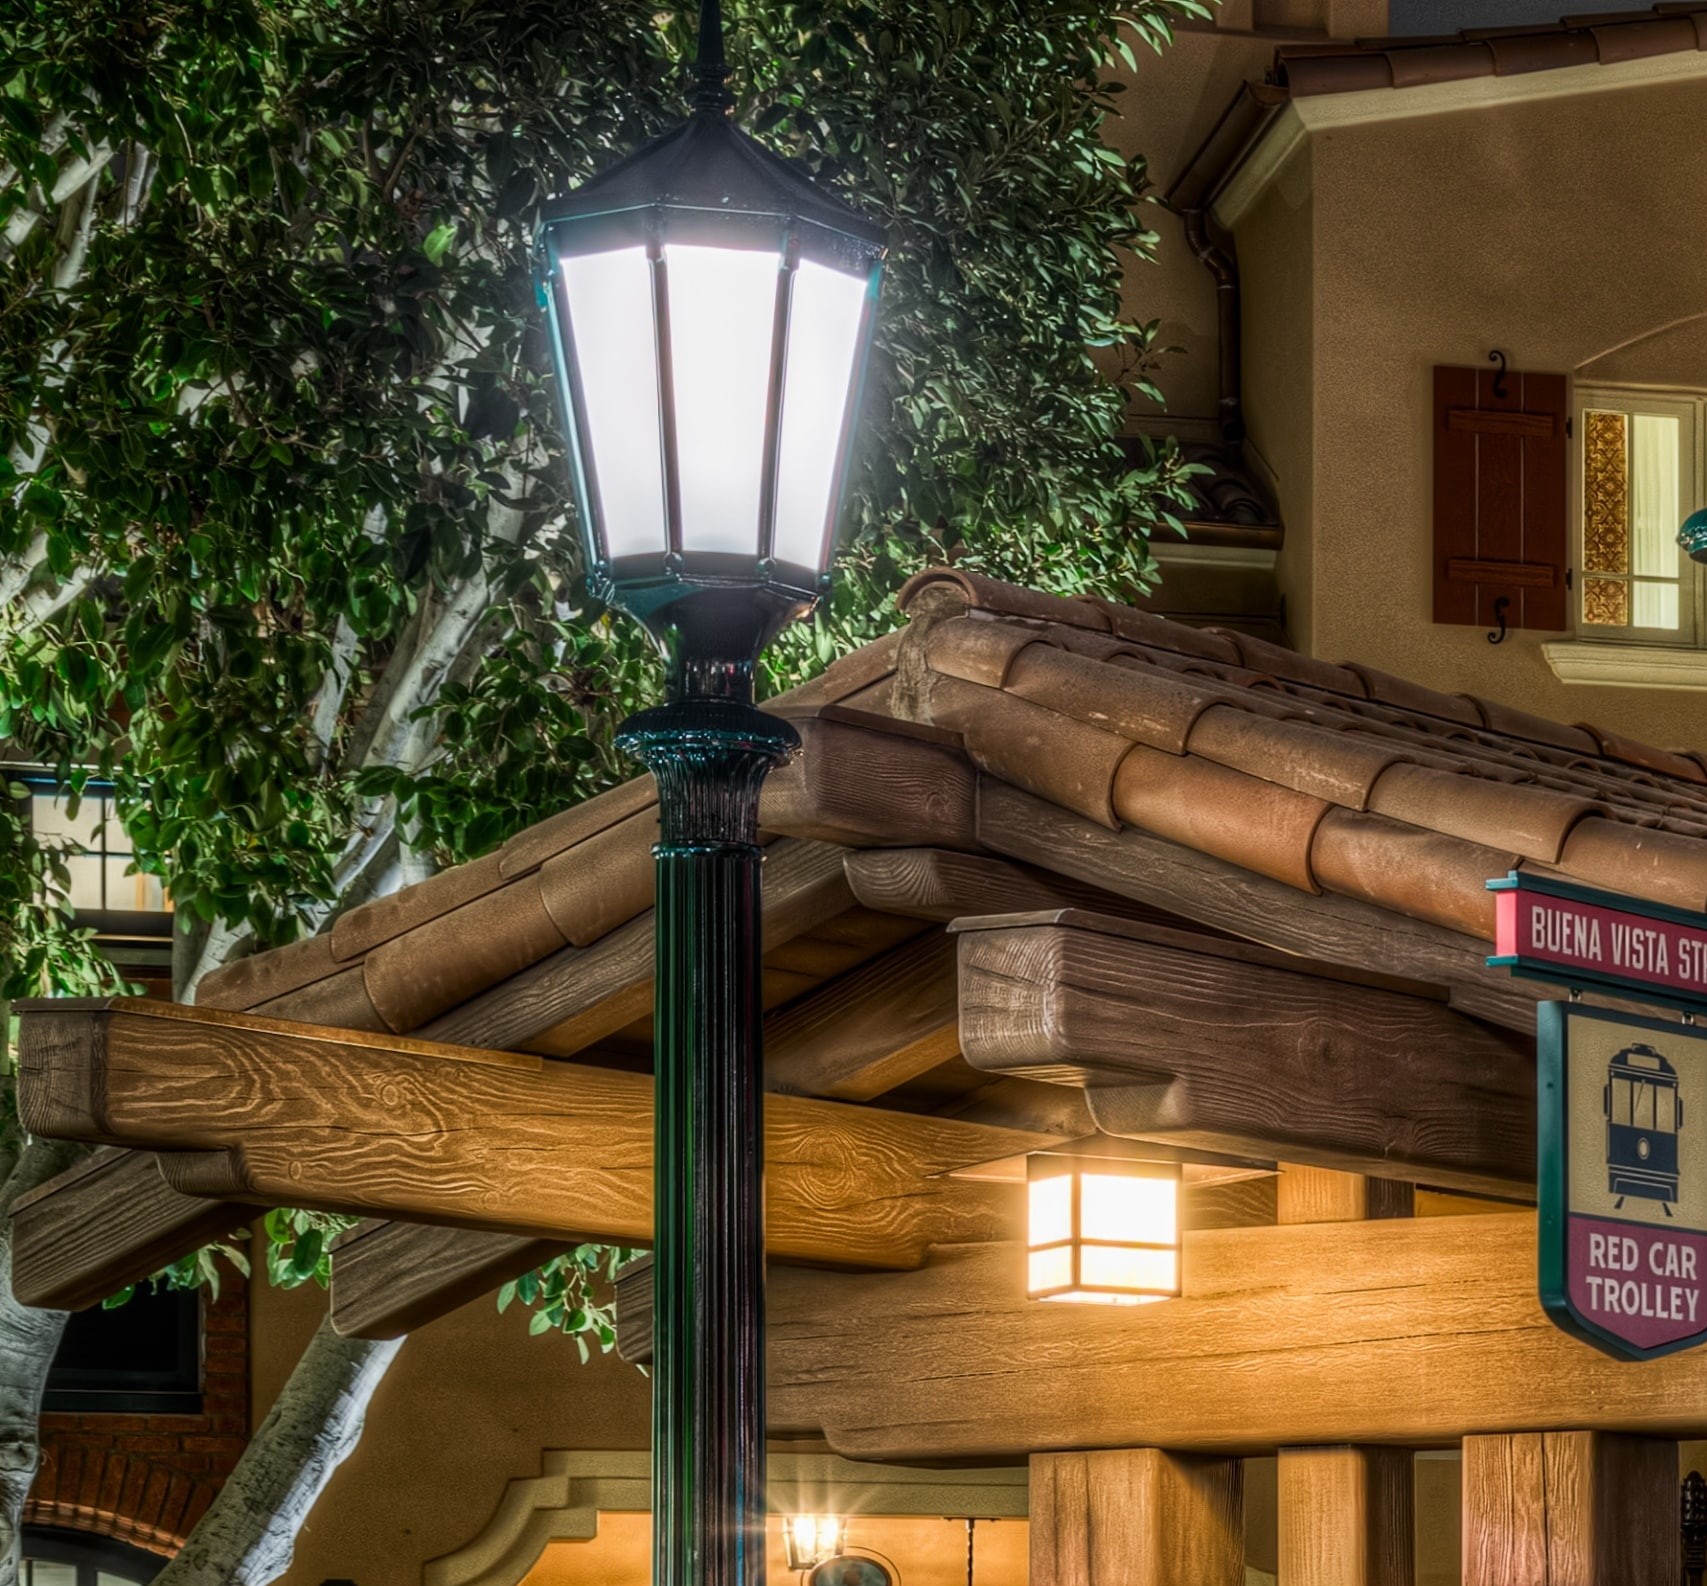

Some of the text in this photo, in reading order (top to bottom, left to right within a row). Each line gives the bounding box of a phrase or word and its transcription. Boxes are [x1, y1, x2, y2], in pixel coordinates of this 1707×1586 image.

[1531, 905, 1602, 962] BUENA
[1611, 922, 1670, 977] VISTA
[1589, 1233, 1698, 1281] RED CAR
[1585, 1275, 1699, 1322] TROLLEY
